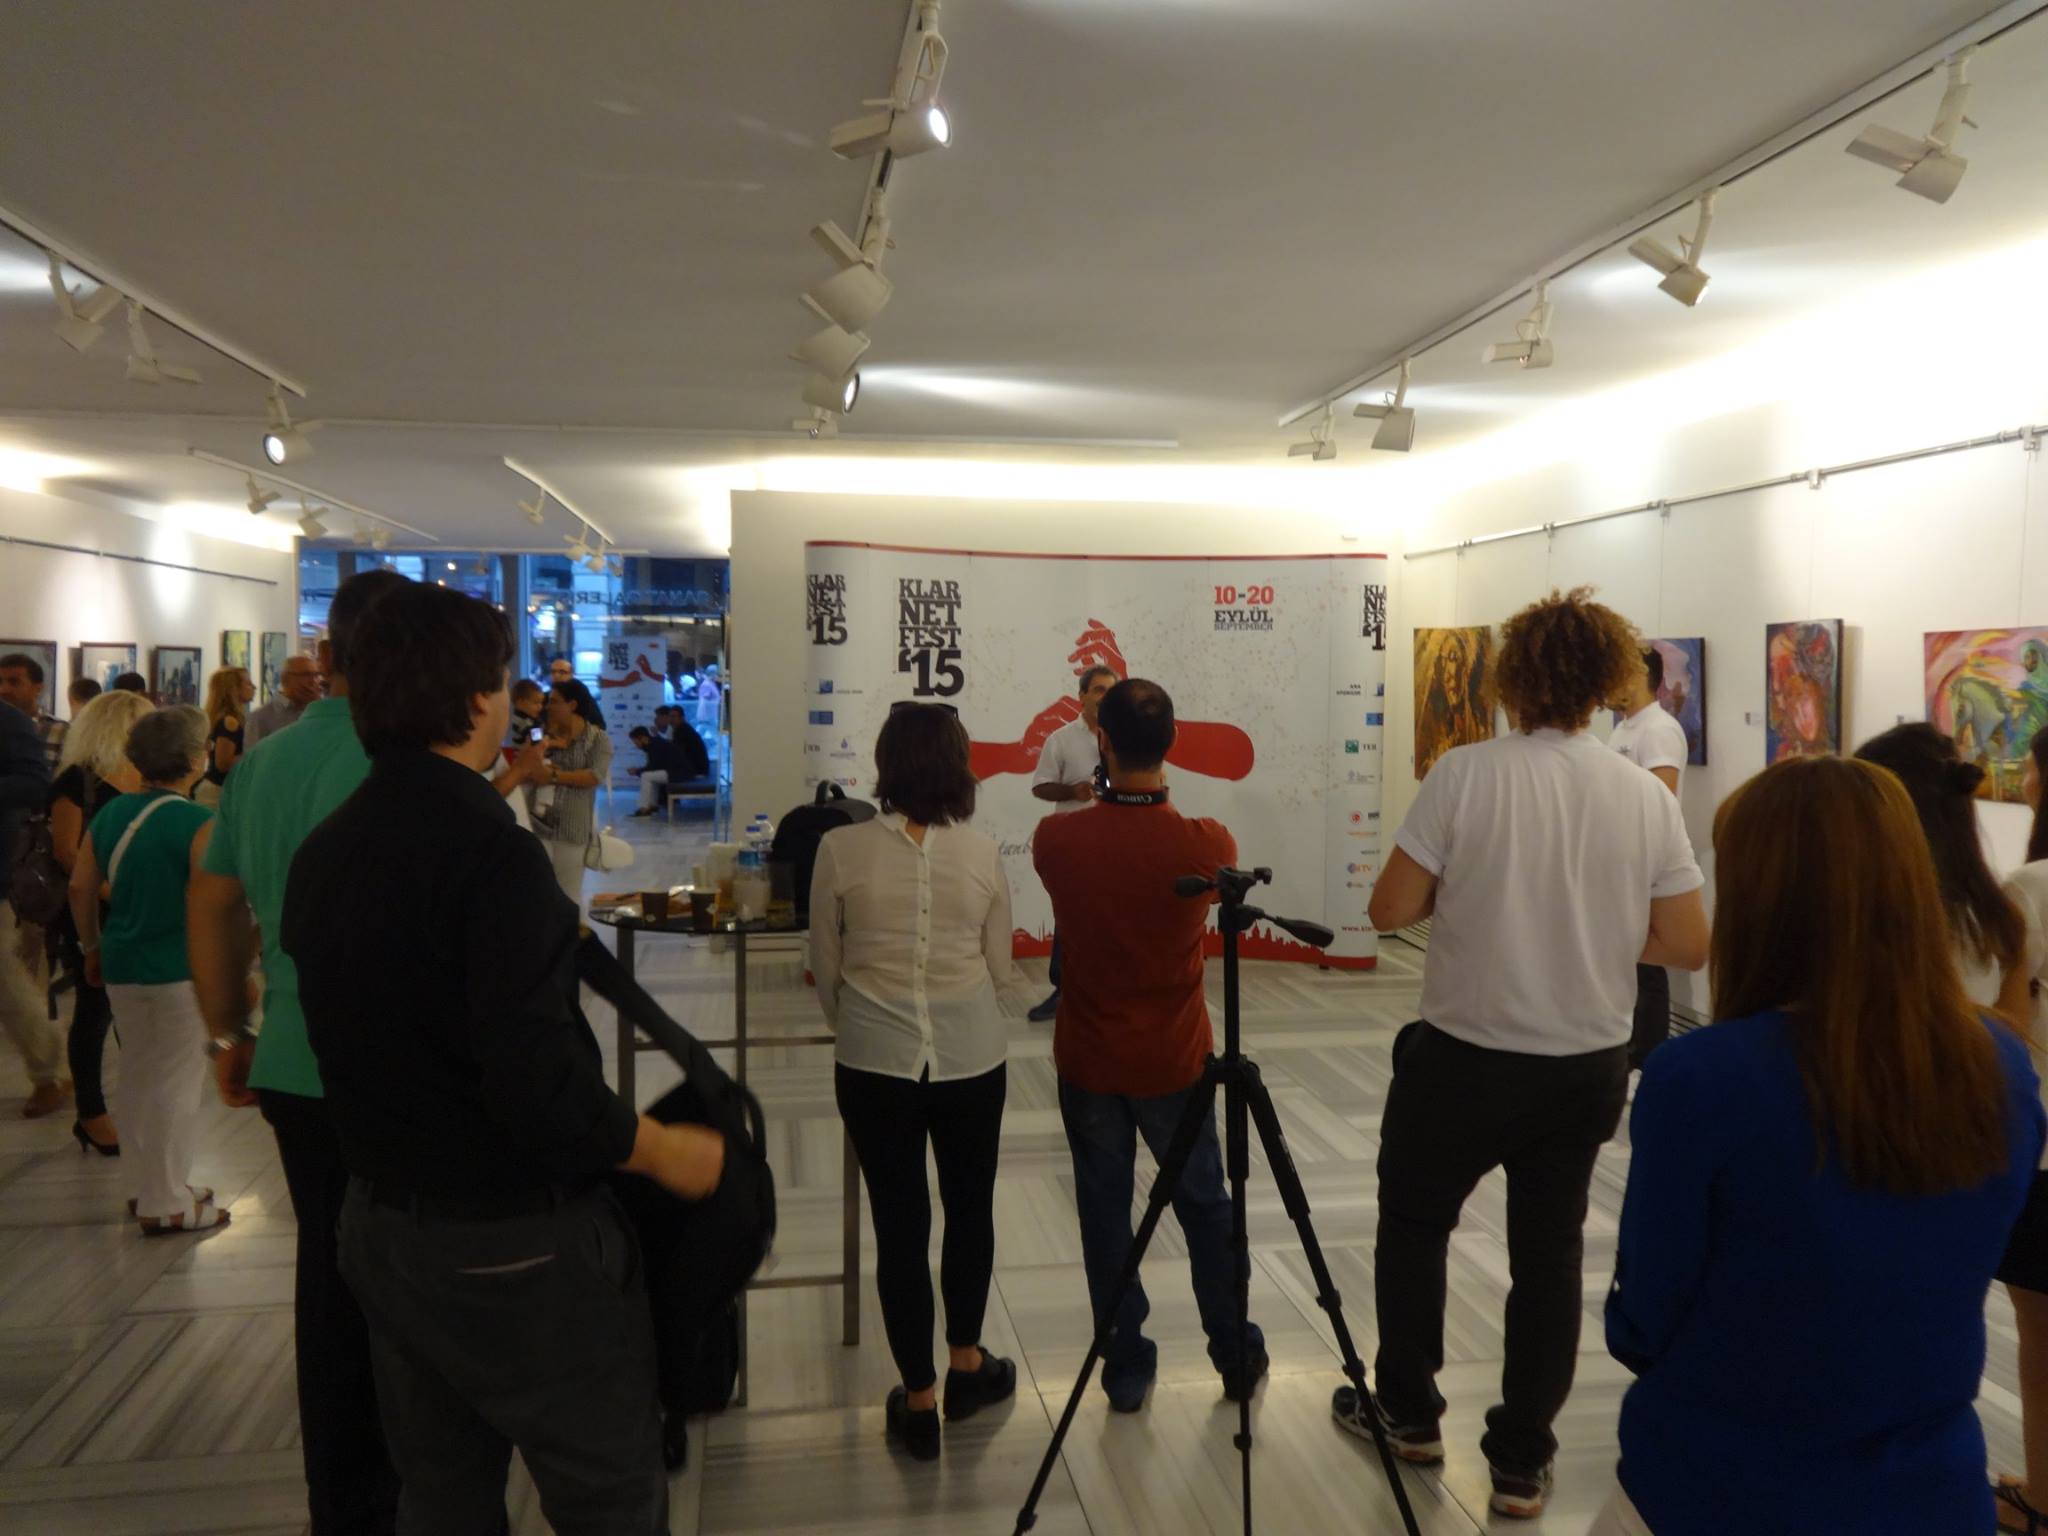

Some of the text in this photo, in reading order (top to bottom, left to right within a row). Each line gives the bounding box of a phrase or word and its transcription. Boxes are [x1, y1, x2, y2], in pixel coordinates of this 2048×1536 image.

[898, 578, 961, 599] KLAR
[1214, 585, 1275, 605] 10-20
[1363, 584, 1386, 599] KLA
[898, 600, 962, 626] NET
[1363, 598, 1386, 612] NE
[1214, 606, 1273, 622] EYLÜL
[1363, 611, 1386, 624] FES
[1214, 622, 1273, 632] SEPTEMBER
[898, 626, 962, 648] FEST
